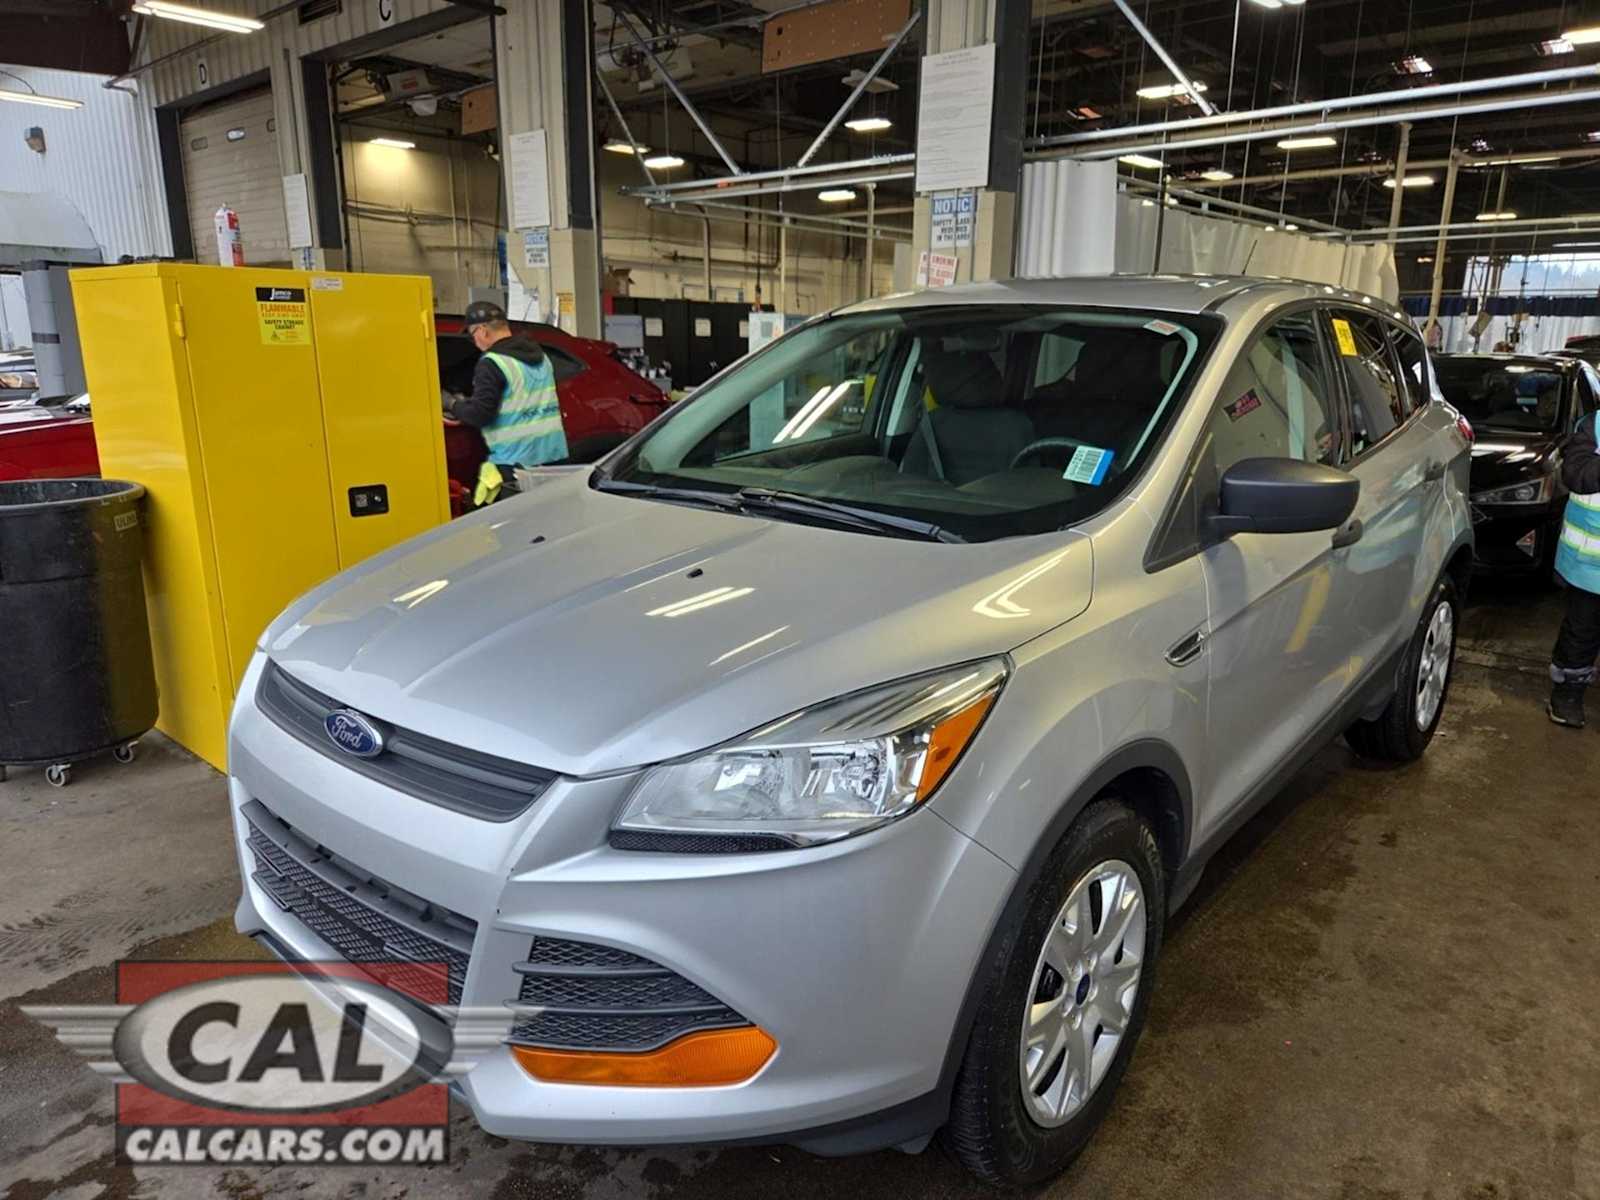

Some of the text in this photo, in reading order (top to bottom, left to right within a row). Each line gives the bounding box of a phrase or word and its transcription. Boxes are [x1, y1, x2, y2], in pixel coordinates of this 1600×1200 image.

[379, 0, 391, 21] C
[199, 63, 207, 84] D
[934, 198, 970, 214] NOTIC
[261, 304, 305, 312] FLAMMABLE
[332, 716, 364, 748] Ford
